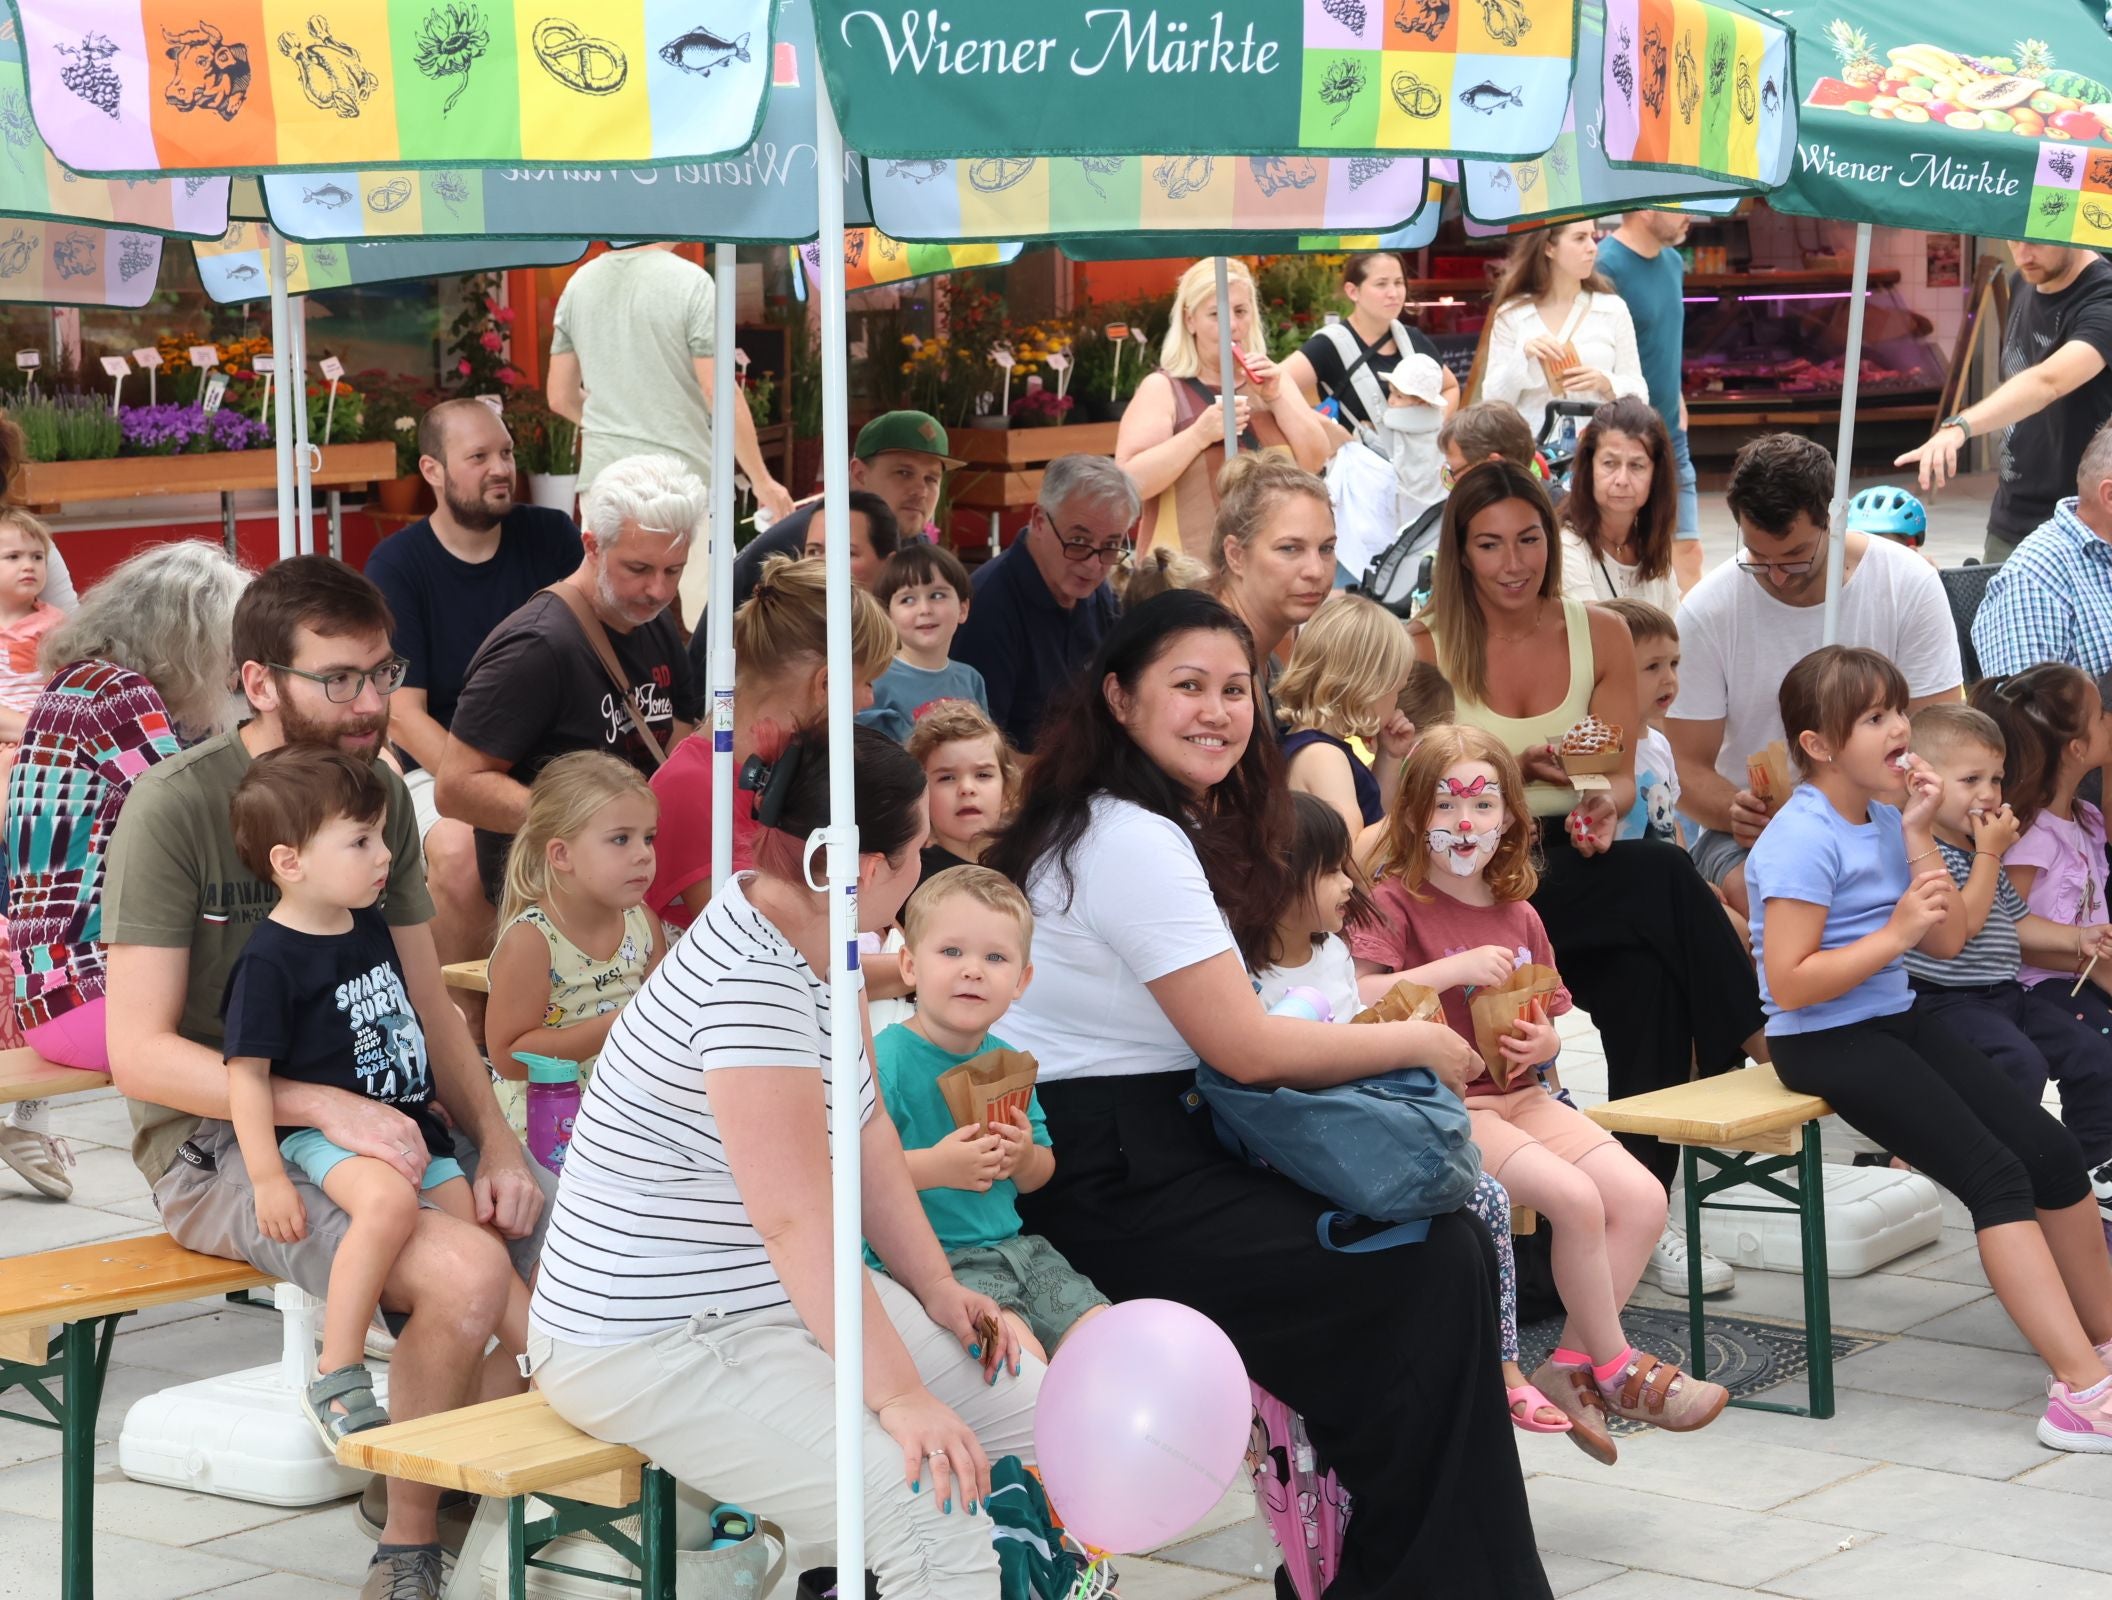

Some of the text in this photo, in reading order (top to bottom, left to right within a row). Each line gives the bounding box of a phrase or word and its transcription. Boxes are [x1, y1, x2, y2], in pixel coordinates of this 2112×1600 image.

[841, 9, 1280, 77] Wiener Märkte
[1798, 143, 2020, 197] Wiener Märkte
[592, 967, 622, 992] YES!
[354, 1030, 378, 1047] WAVE
[356, 1026, 371, 1038] BIG
[353, 1036, 381, 1055] STORY
[356, 1047, 385, 1065] COOL
[366, 1069, 397, 1097] LA
